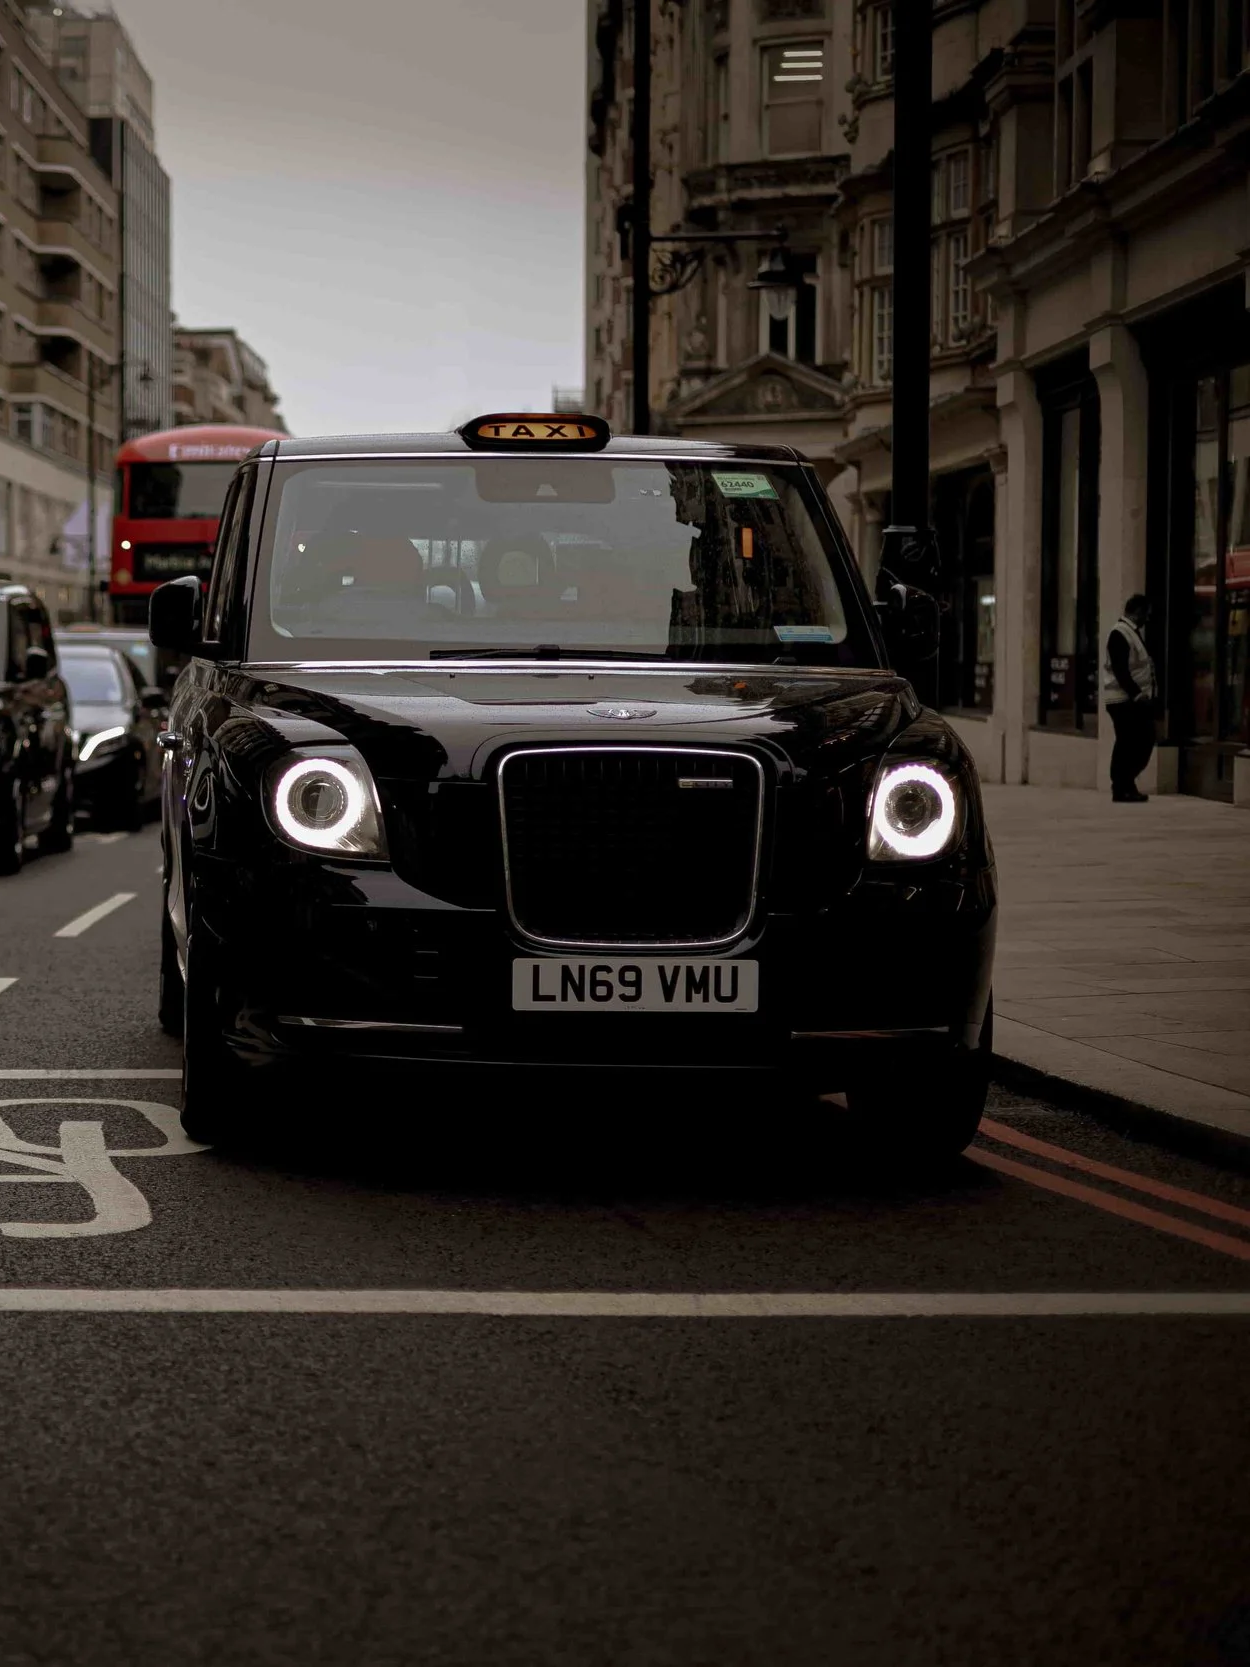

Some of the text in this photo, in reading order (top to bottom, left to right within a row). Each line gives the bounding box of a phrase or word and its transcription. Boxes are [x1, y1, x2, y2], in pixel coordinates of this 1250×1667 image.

[488, 424, 586, 438] TAXI
[532, 964, 739, 1003] LN69 VMU
